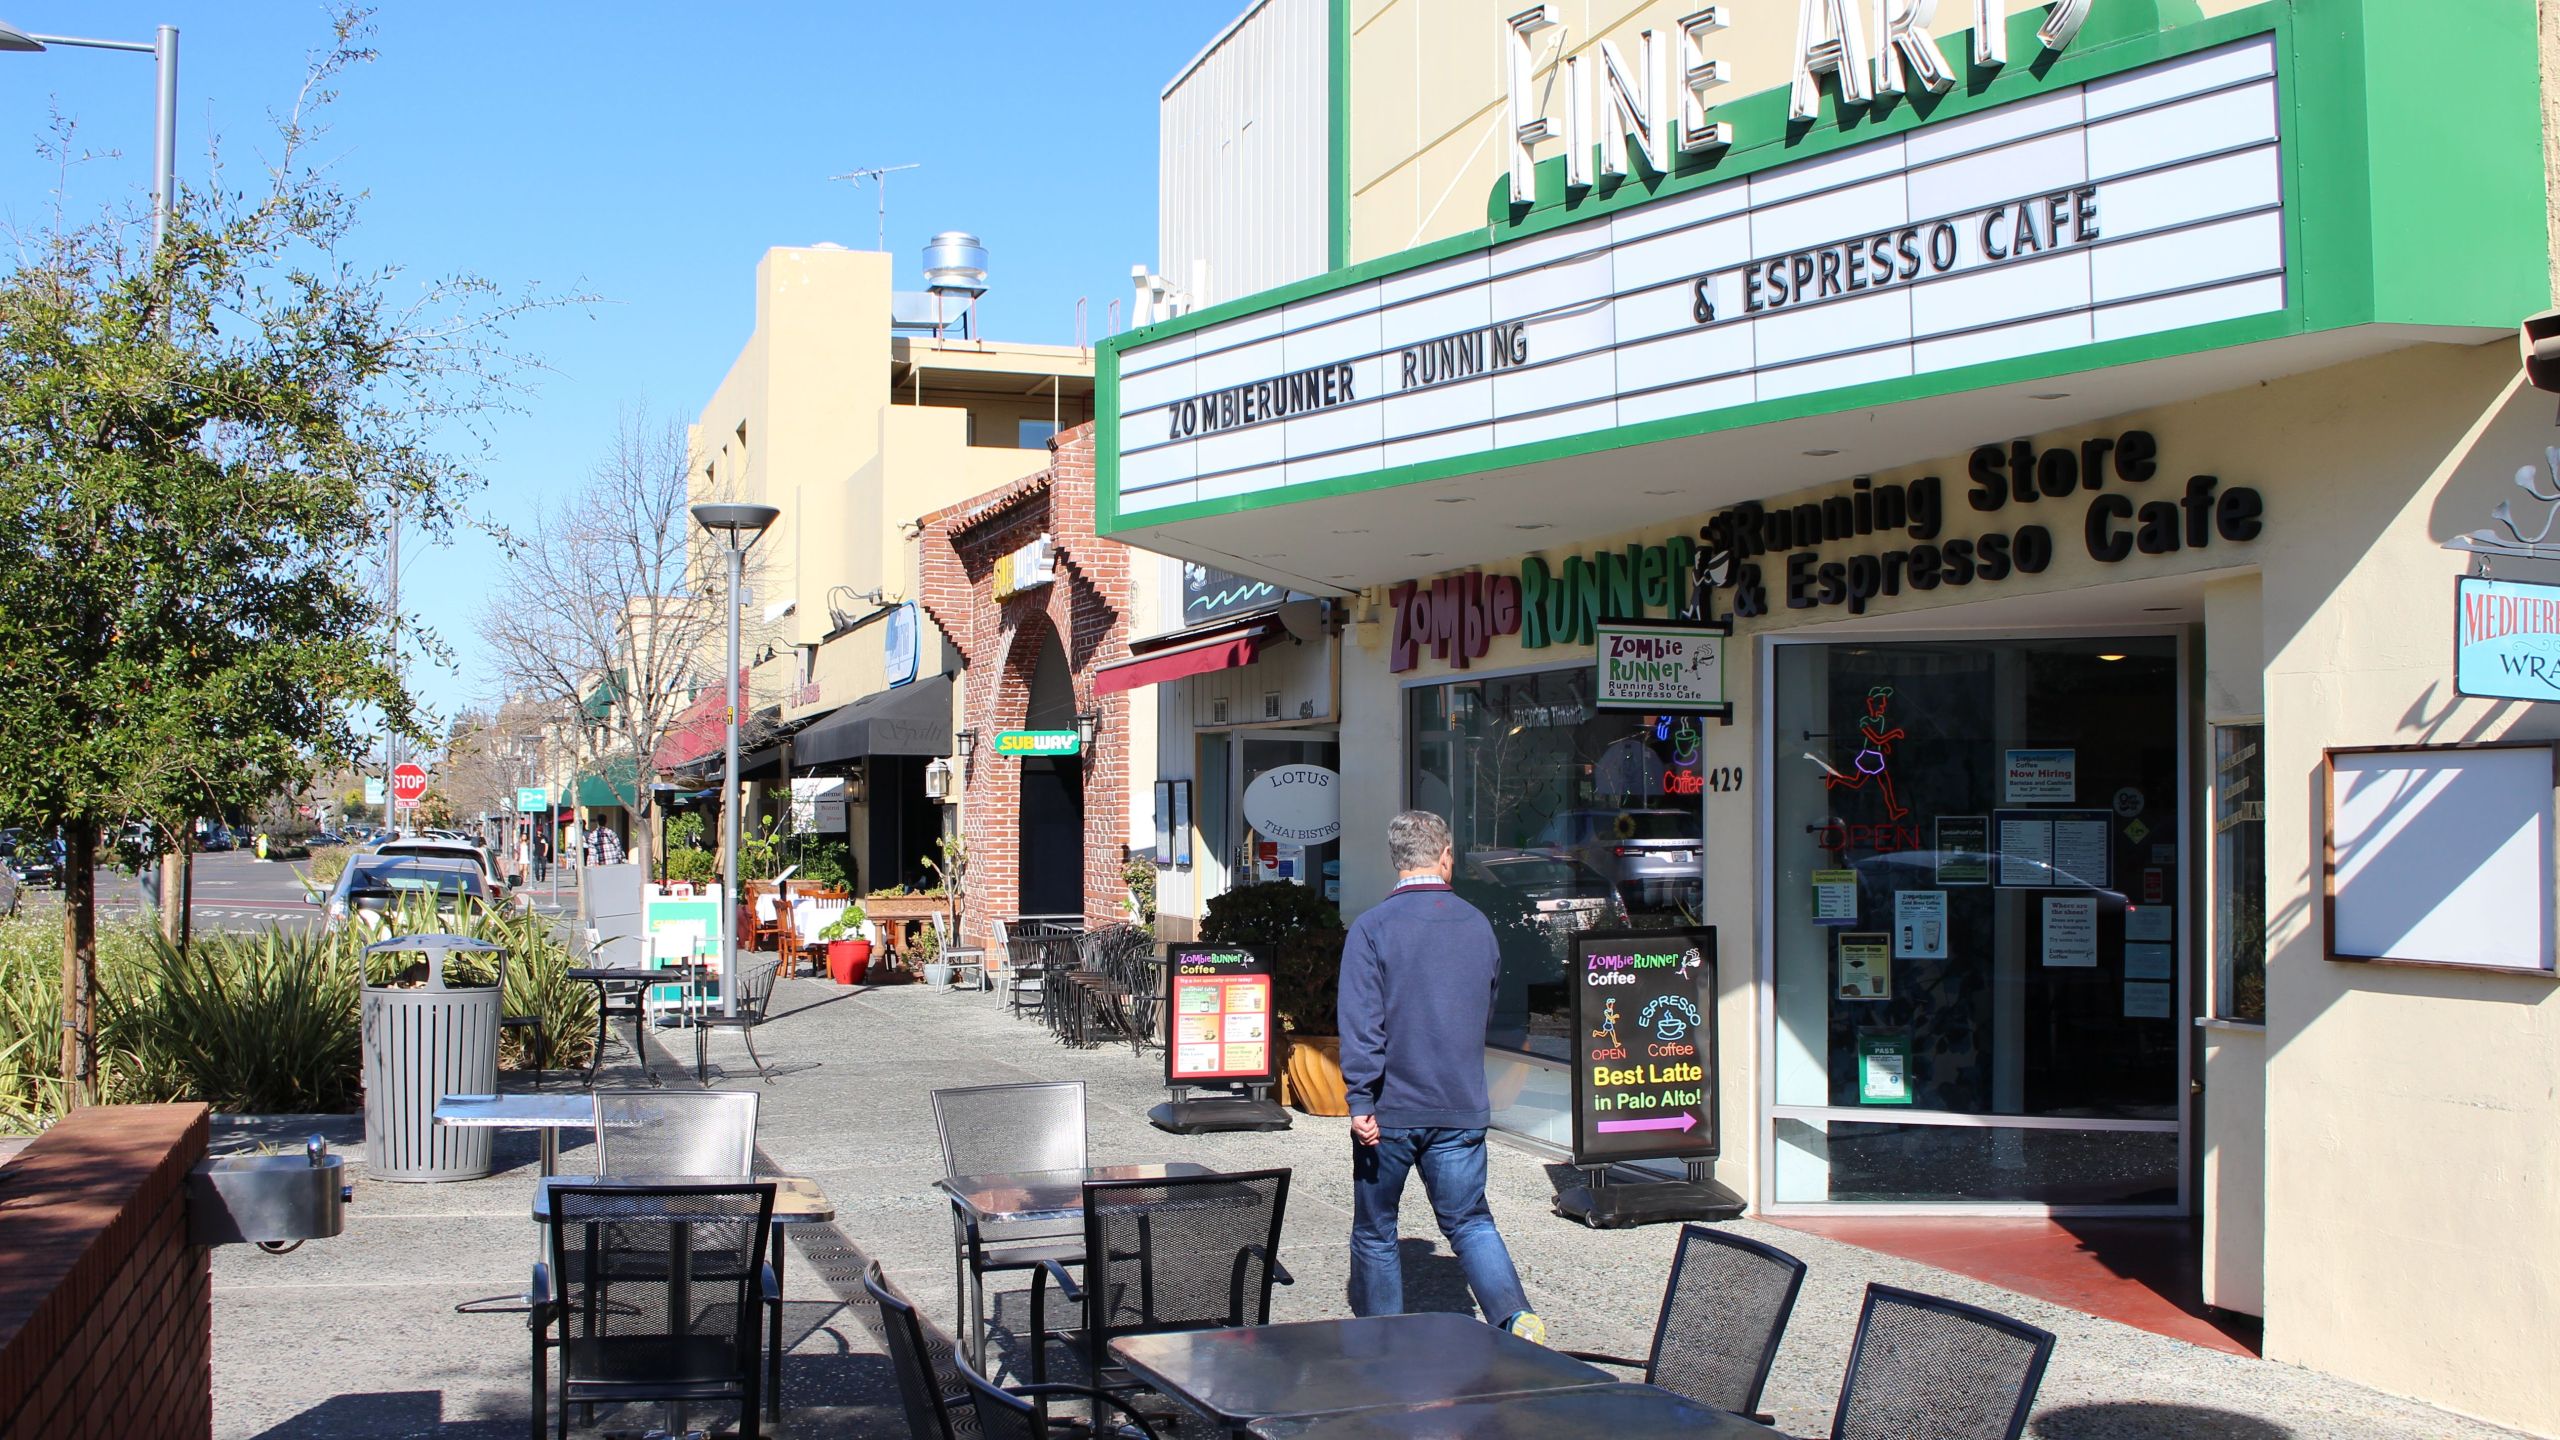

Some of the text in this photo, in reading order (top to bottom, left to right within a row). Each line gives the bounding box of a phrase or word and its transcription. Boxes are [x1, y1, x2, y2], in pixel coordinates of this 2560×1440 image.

[1506, 5, 1732, 204] FINE
[1693, 186, 2100, 323] & ESPRESSO CAFE
[1169, 322, 1528, 439] ZOMBIERUNNER RUNNING
[1732, 430, 2157, 558] Running Store
[1734, 475, 2263, 618] & Espresso Cafe
[1608, 689, 1702, 699] & Espresso Cafe
[1609, 681, 1688, 692] Running Store
[999, 734, 1077, 751] SUBWAY
[394, 775, 425, 789] STOP
[1270, 771, 1329, 788] LOTUS
[1664, 770, 1704, 794] Coffee
[1710, 767, 1743, 792] 429
[2010, 769, 2072, 780] Now Hiring
[522, 792, 532, 807] P
[1264, 819, 1340, 840] THAI BISTRO
[1820, 823, 1919, 850] OPEN
[196, 910, 304, 921] STOP
[1180, 965, 1216, 974] Coffee
[1588, 973, 1636, 986] Coffee
[1638, 995, 1701, 1028] ESPRESSO
[1591, 1048, 1627, 1061] OPEN
[1648, 1043, 1694, 1057] Coffee
[1593, 1062, 1702, 1087] Best Latte
[1594, 1088, 1702, 1112] in Palo Alto!
